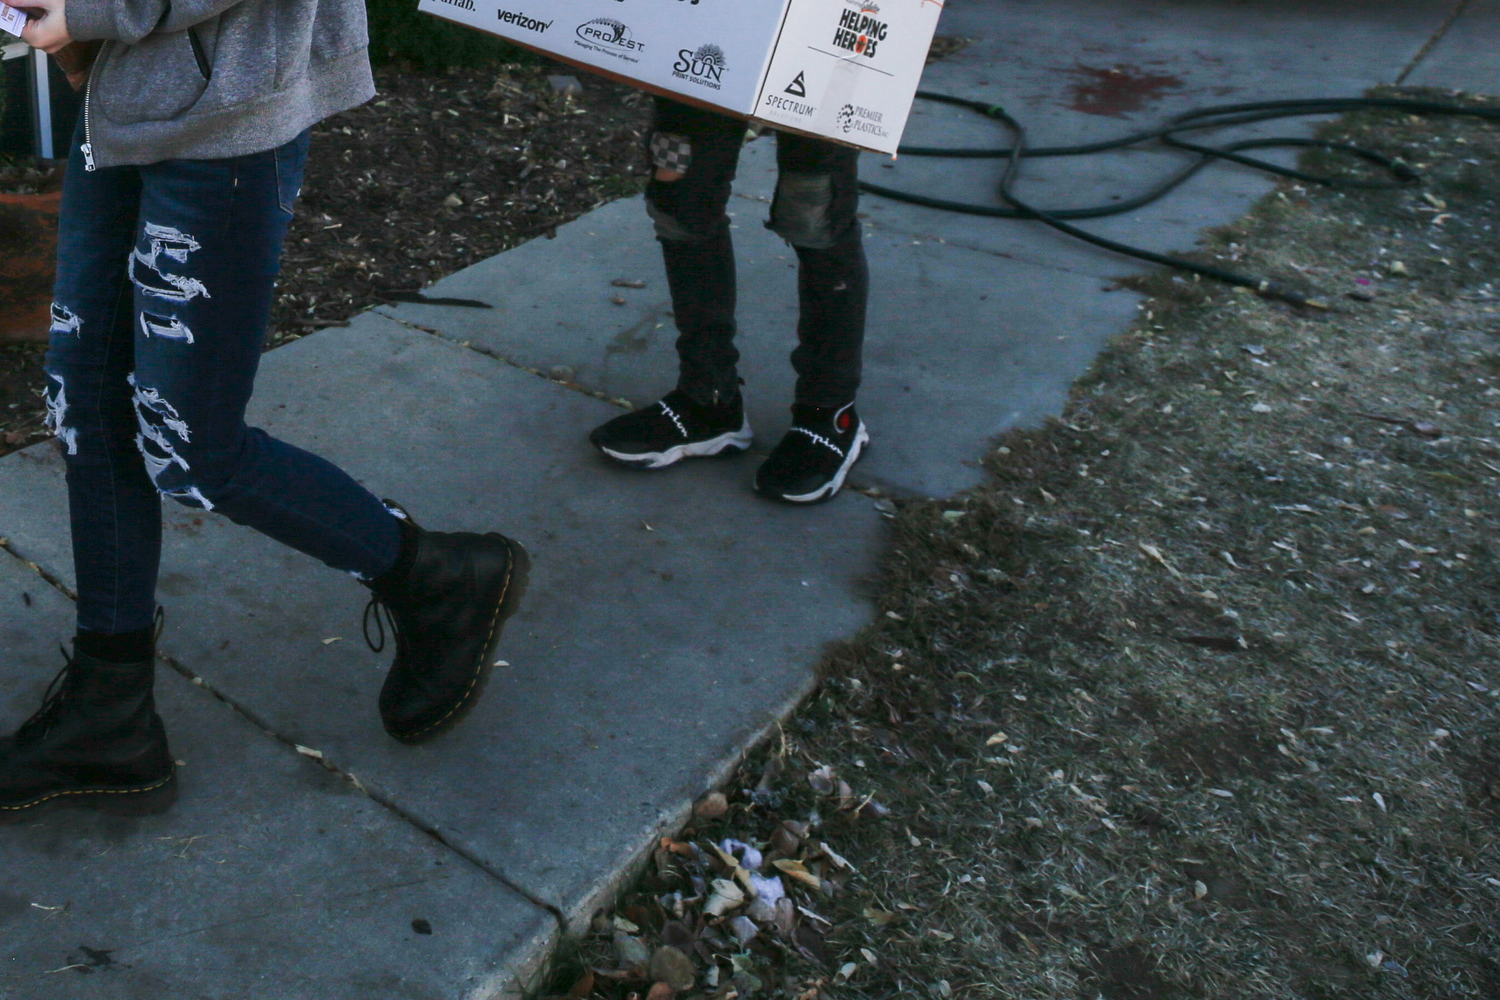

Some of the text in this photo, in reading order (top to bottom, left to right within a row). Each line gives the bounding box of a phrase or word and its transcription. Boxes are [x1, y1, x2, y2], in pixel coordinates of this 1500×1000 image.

[497, 9, 546, 33] verizon
[839, 8, 888, 41] HELPING
[832, 27, 878, 58] HEROES
[672, 71, 721, 90] PRINT SOLUTIONS
[766, 95, 814, 117] SPECTRUM
[855, 106, 883, 122] PREMIER
[854, 120, 882, 136] PLASTICS
